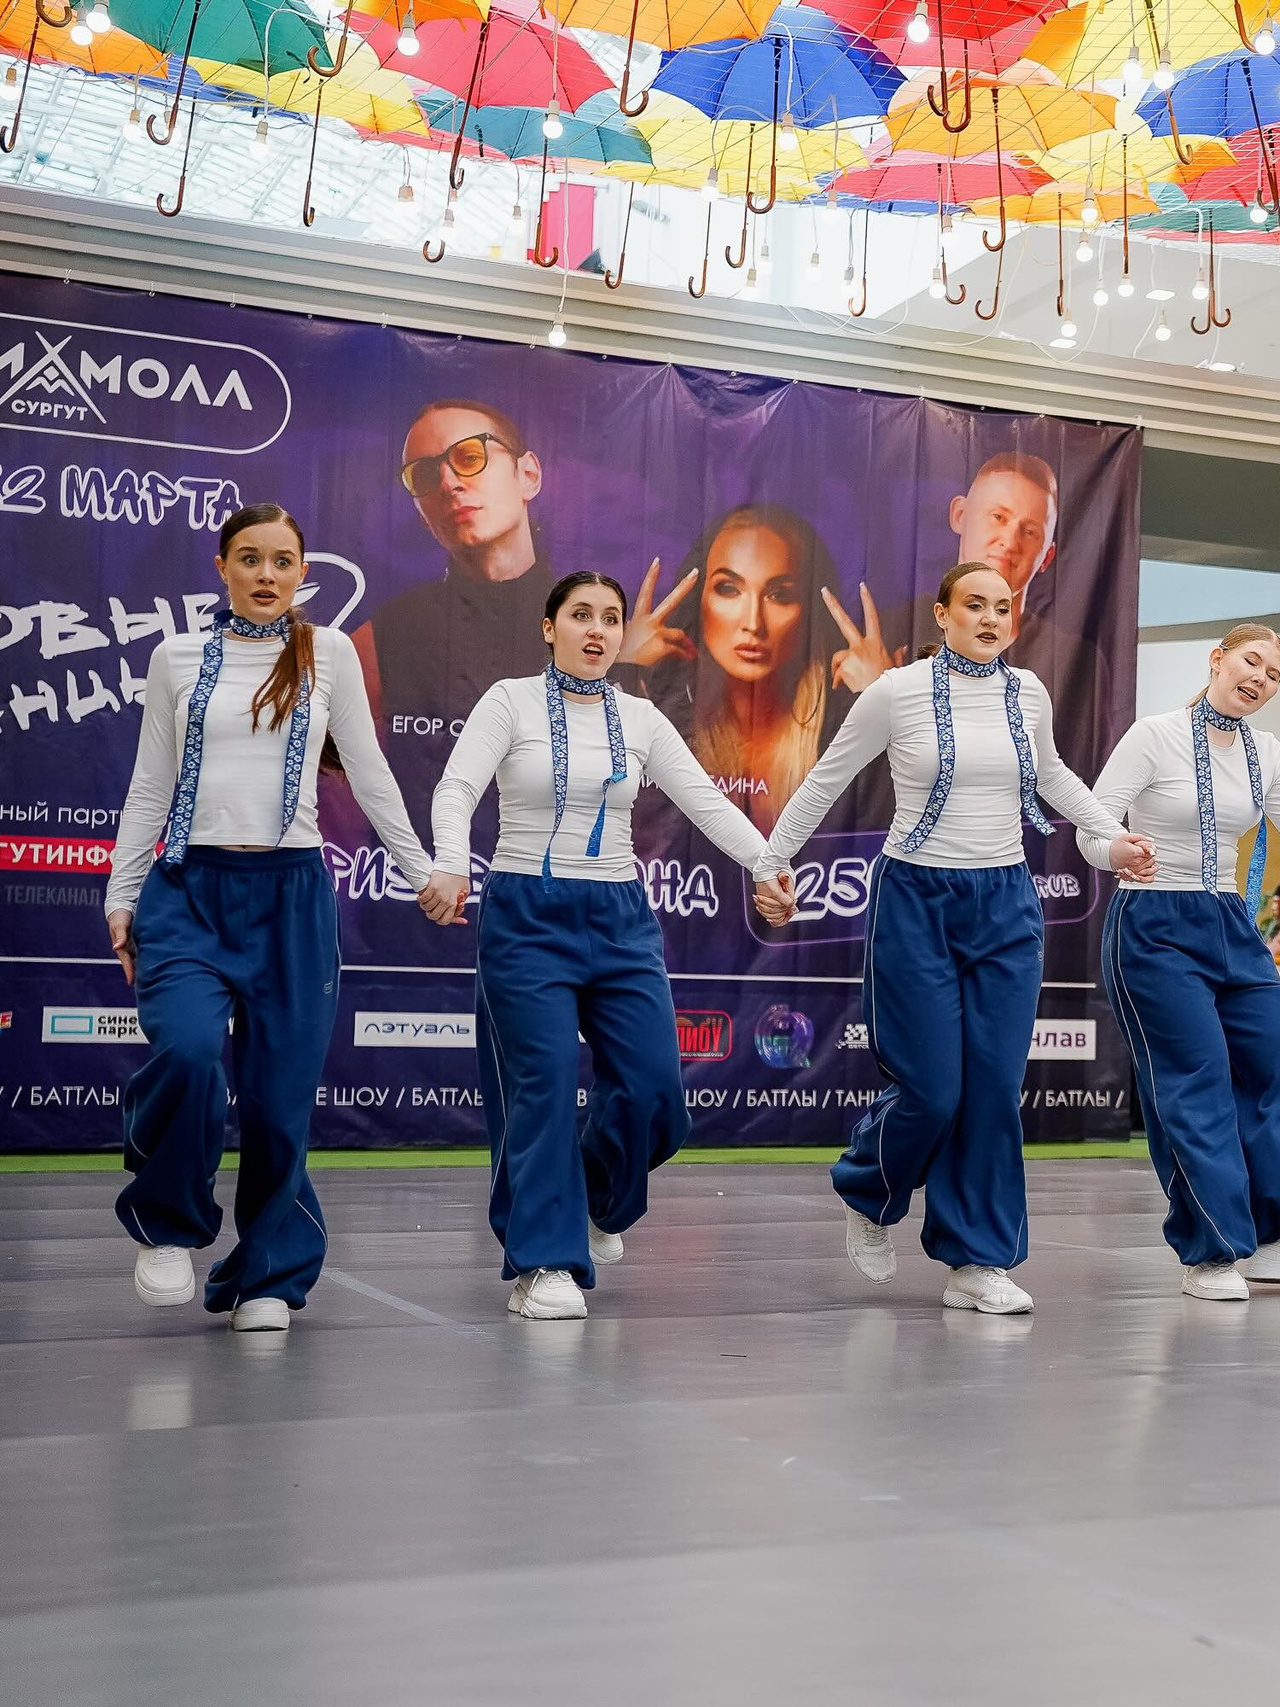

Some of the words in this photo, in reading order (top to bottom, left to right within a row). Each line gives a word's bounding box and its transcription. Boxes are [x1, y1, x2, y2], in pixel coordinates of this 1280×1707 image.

[80, 350, 253, 411] МОЛЛ
[11, 399, 88, 421] СУРГУТ
[0, 464, 46, 514] 2
[60, 464, 243, 532] МАРТА
[393, 715, 443, 735] ЕГОР
[709, 774, 769, 795] ДИНА
[58, 806, 124, 829] парт
[0, 841, 116, 866] УТИНФ
[5, 885, 101, 906] ТЕЛЕКАНАЛ
[98, 1026, 138, 1039] парк
[30, 1086, 120, 1106] БАТТЛЫ
[333, 1087, 390, 1106] ШОУ
[747, 1088, 816, 1107] БАТТЛЫ
[1045, 1089, 1111, 1107] БАТТЛЫ
